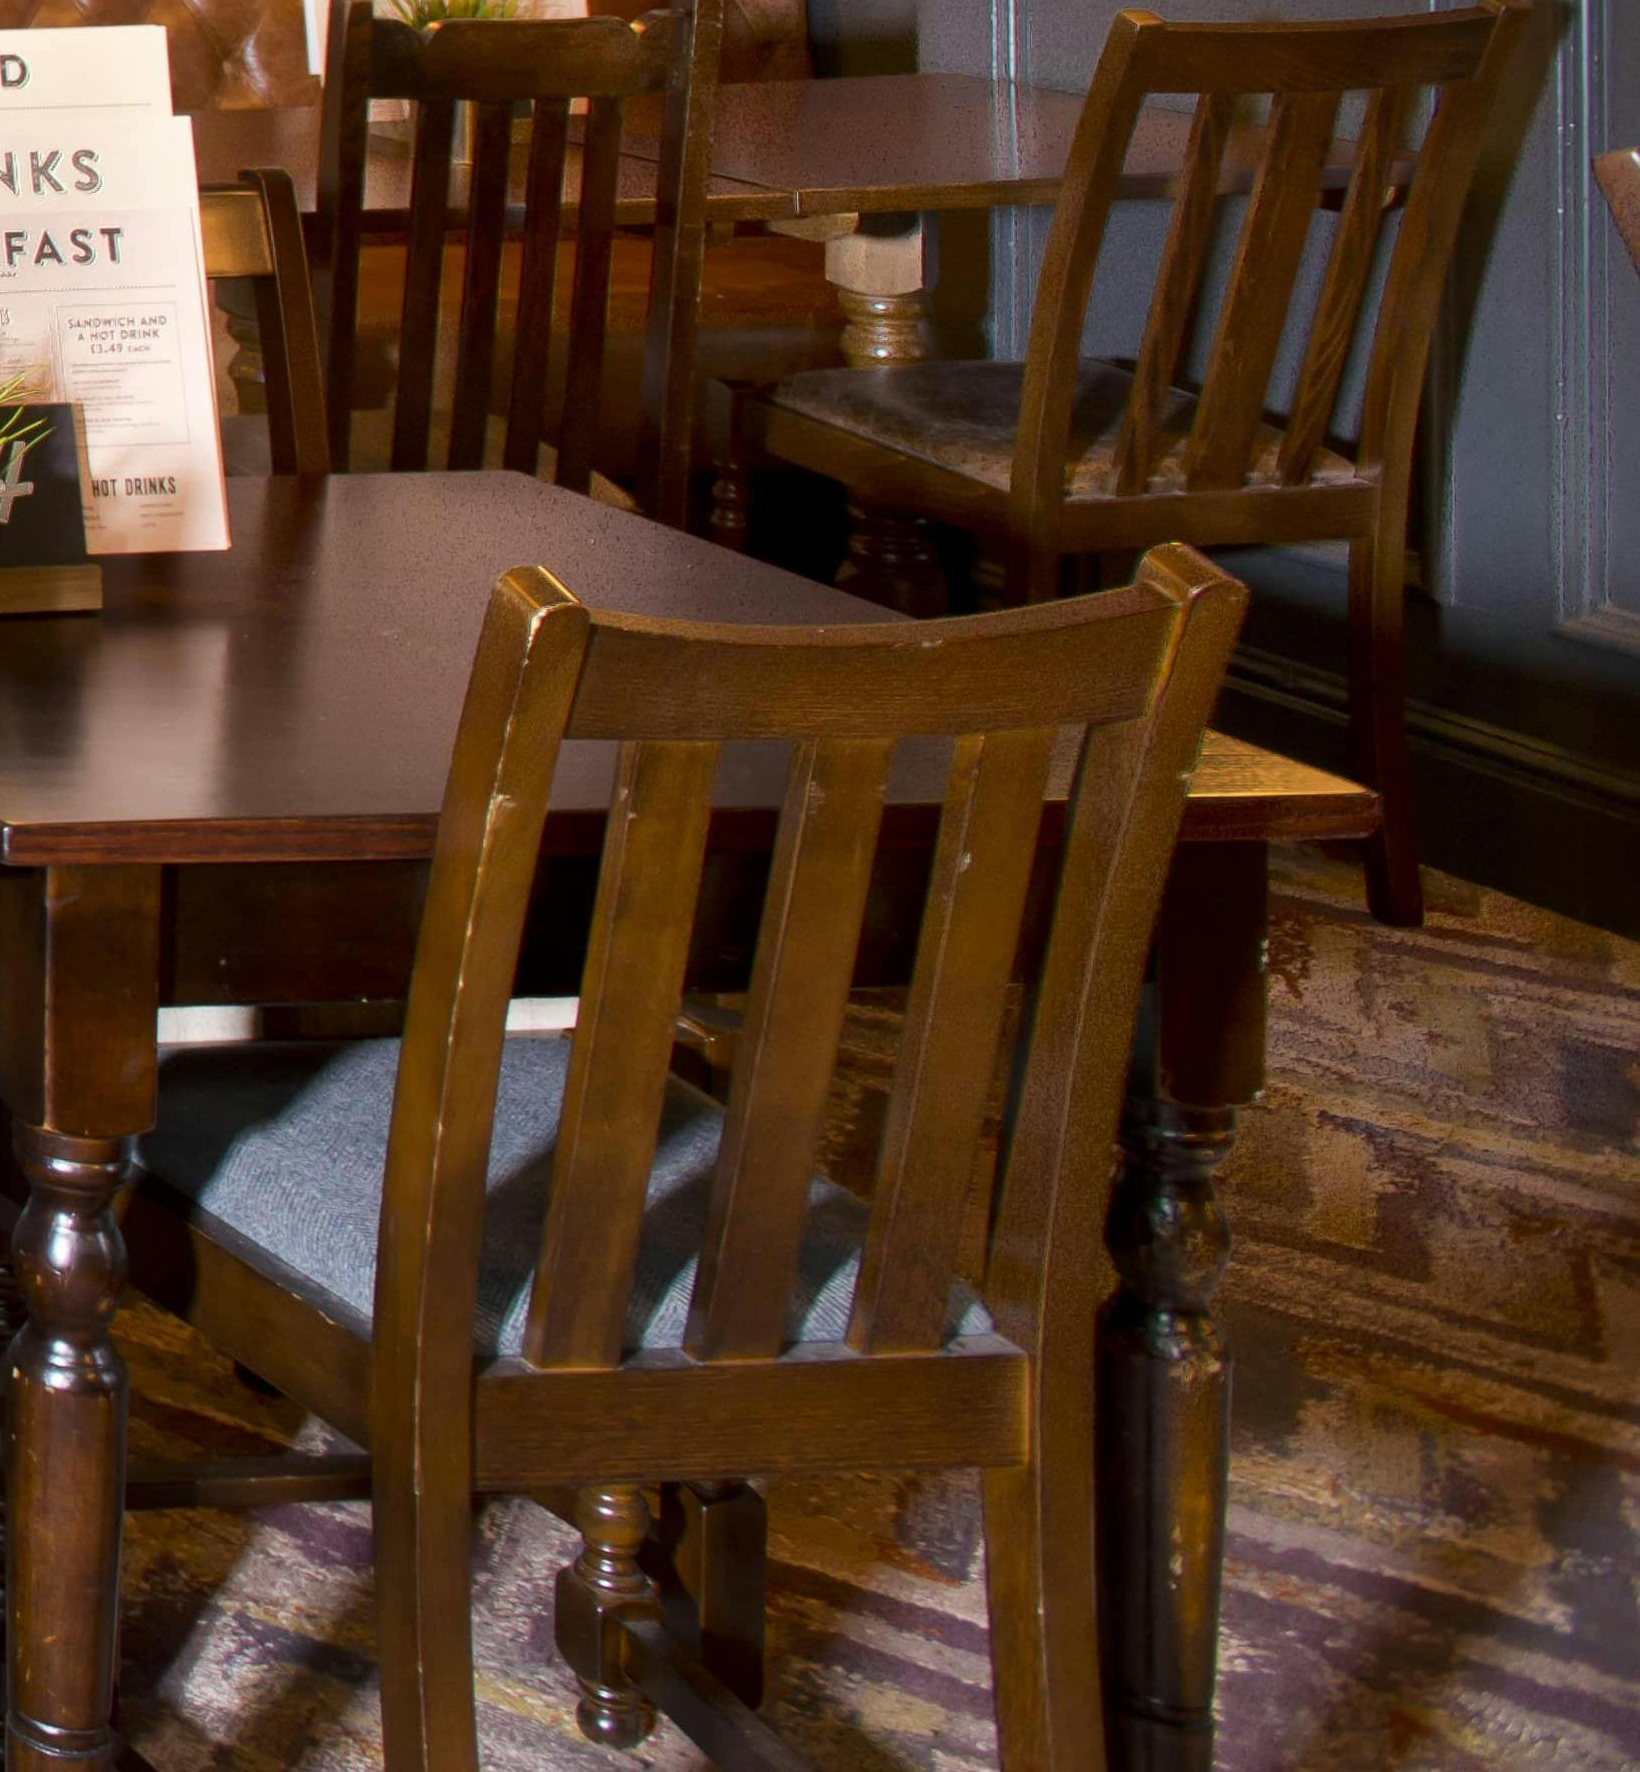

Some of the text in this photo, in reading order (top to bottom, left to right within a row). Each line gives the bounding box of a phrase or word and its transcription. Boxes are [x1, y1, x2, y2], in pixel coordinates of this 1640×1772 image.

[67, 315, 167, 329] SANDWICH AND
[90, 330, 115, 340] HOT
[121, 328, 160, 340] DRINK
[92, 476, 177, 497] HOT DRINKS
